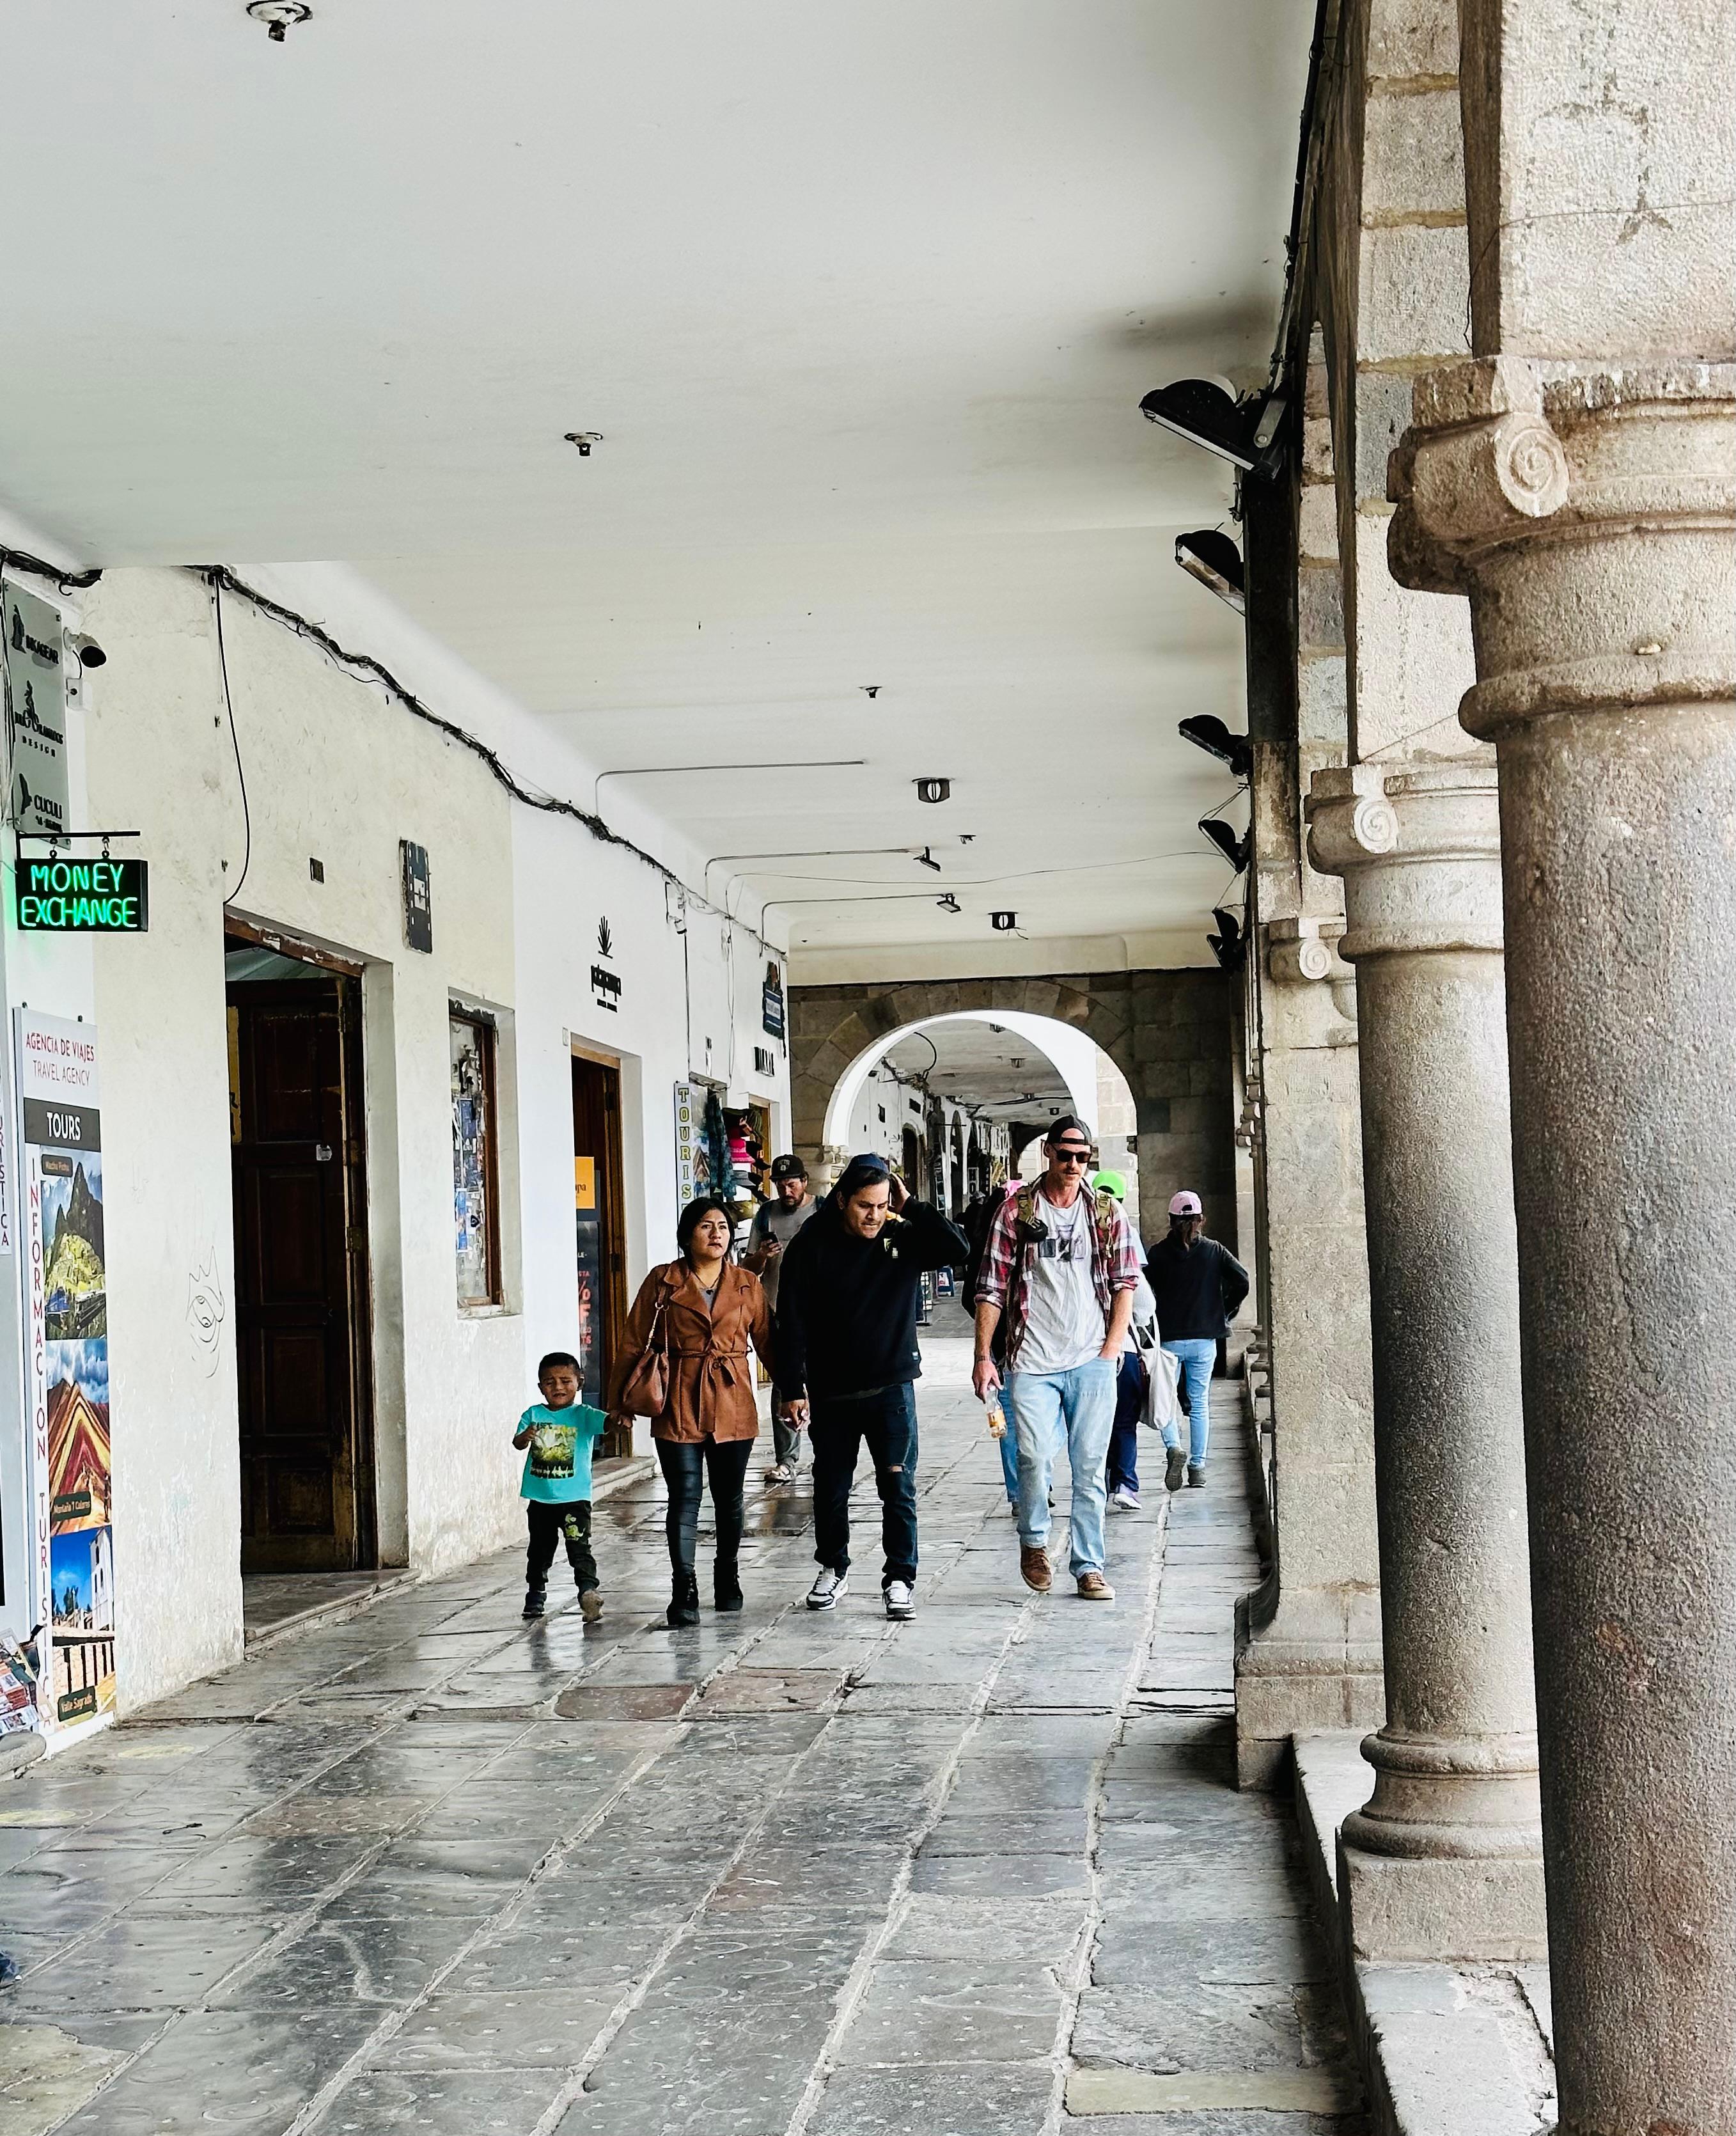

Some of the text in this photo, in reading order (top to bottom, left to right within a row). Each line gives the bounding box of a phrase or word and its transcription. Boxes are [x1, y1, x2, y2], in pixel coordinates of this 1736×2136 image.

[31, 863, 124, 892] MONEY
[21, 896, 138, 928] EXCHANGE
[26, 1031, 95, 1063] AGENCIA DE VIAJES
[33, 1060, 90, 1087] TRAVEL AGENCY
[47, 1111, 81, 1141] TOURS
[678, 1088, 692, 1211] TOURIS
[575, 1183, 586, 1194] pa
